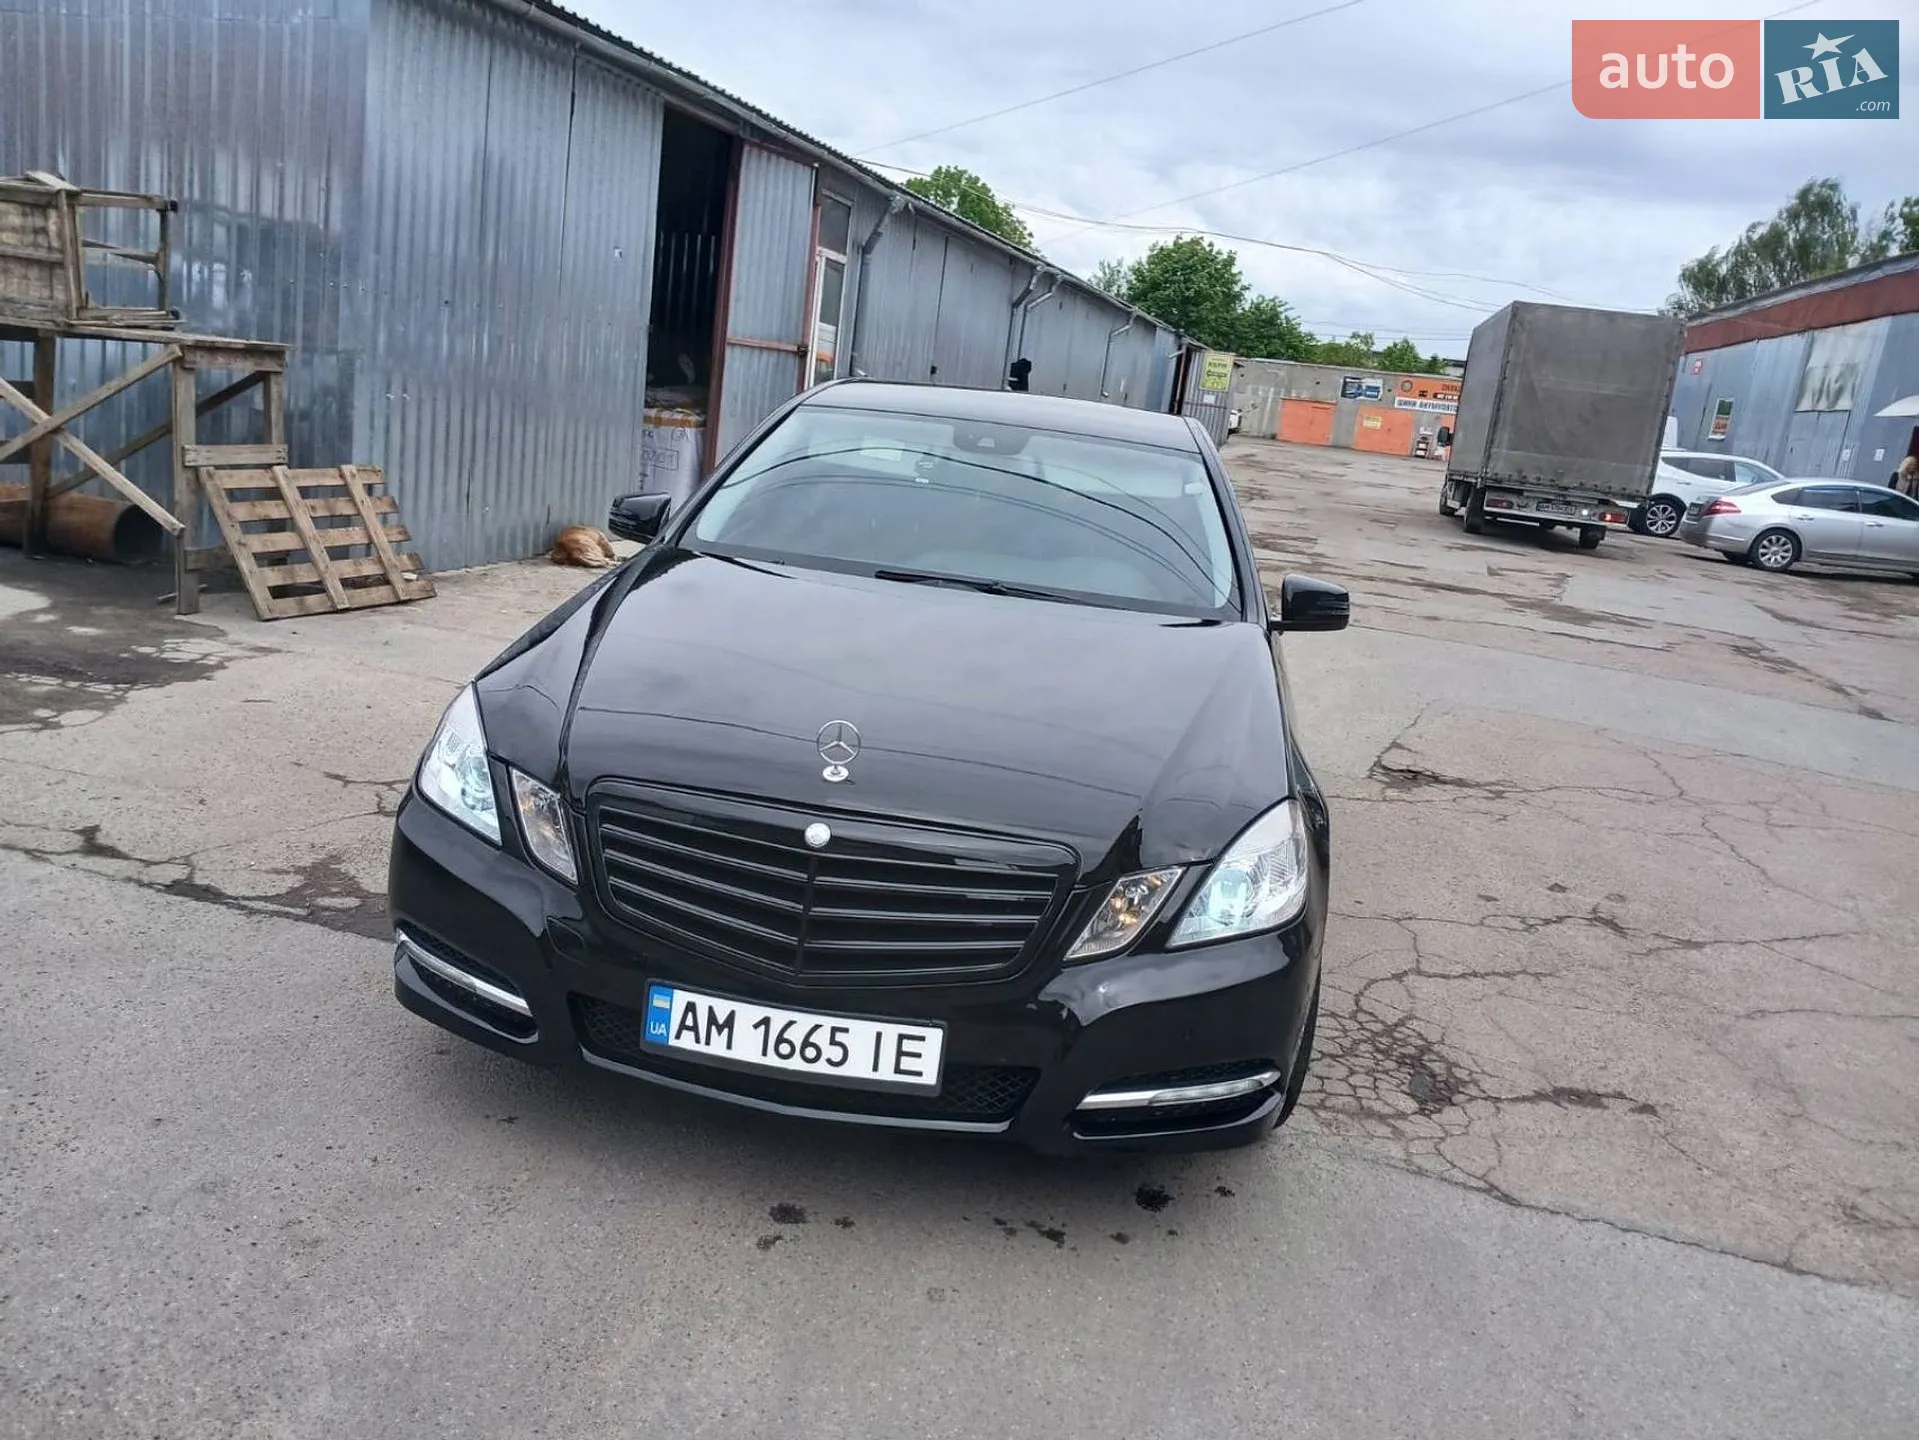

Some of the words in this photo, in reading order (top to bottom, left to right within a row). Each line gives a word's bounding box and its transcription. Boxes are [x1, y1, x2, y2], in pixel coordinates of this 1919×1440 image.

[650, 1020, 668, 1036] UA
[674, 1001, 736, 1050] AM
[752, 1016, 850, 1068] 1665
[871, 1031, 927, 1077] IE
